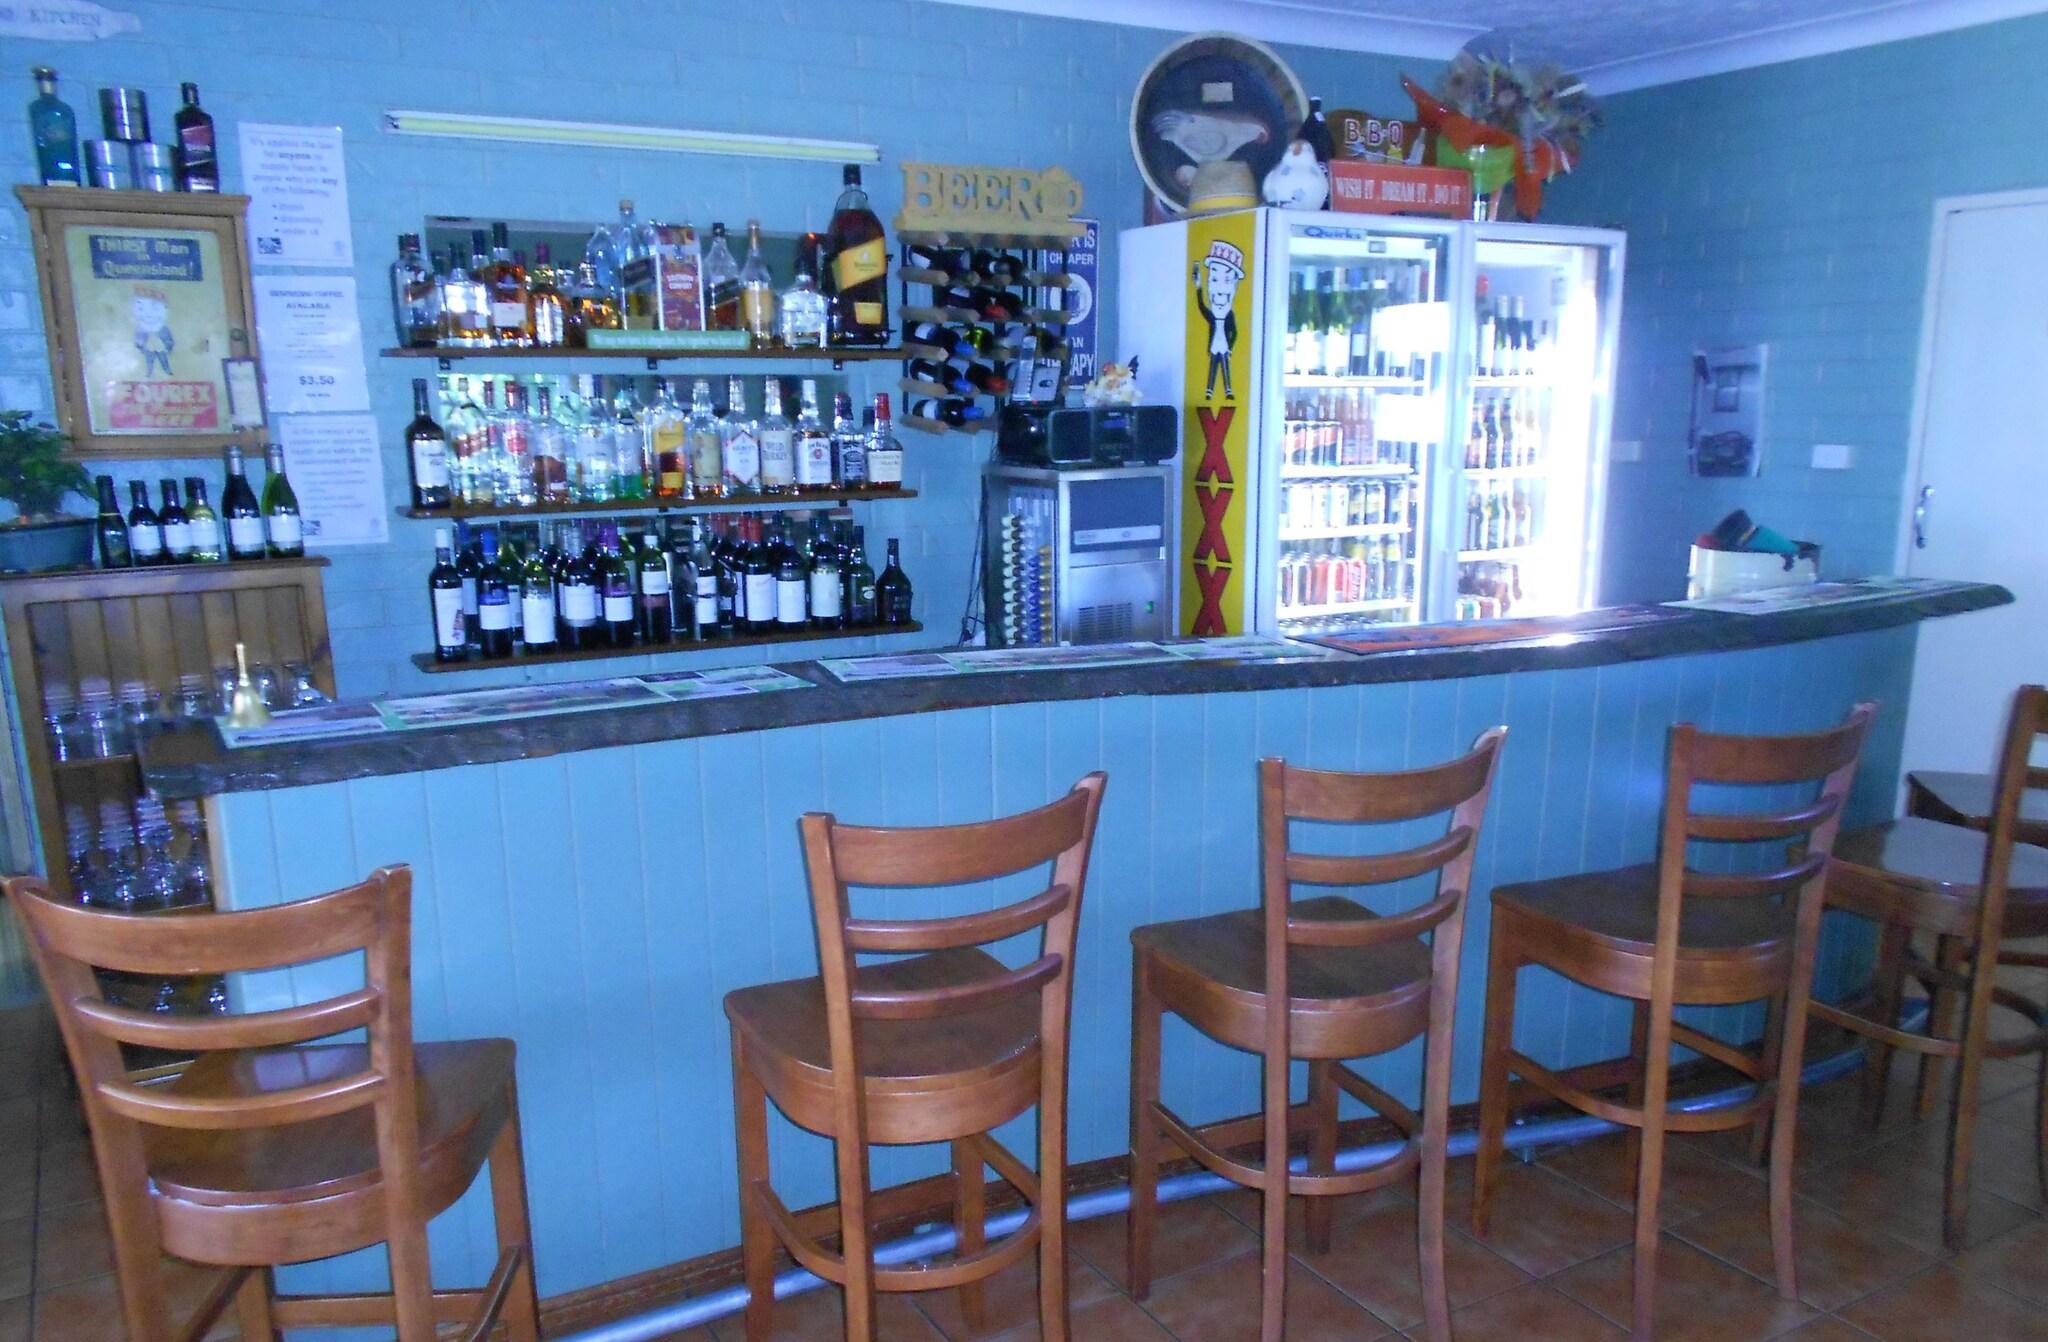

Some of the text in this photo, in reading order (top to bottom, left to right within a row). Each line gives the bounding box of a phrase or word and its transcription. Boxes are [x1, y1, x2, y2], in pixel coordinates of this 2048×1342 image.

[903, 165, 1042, 219] BEER
[1050, 253, 1094, 265] CHAPER
[1213, 245, 1241, 265] XXXX
[299, 375, 336, 386] $3.50
